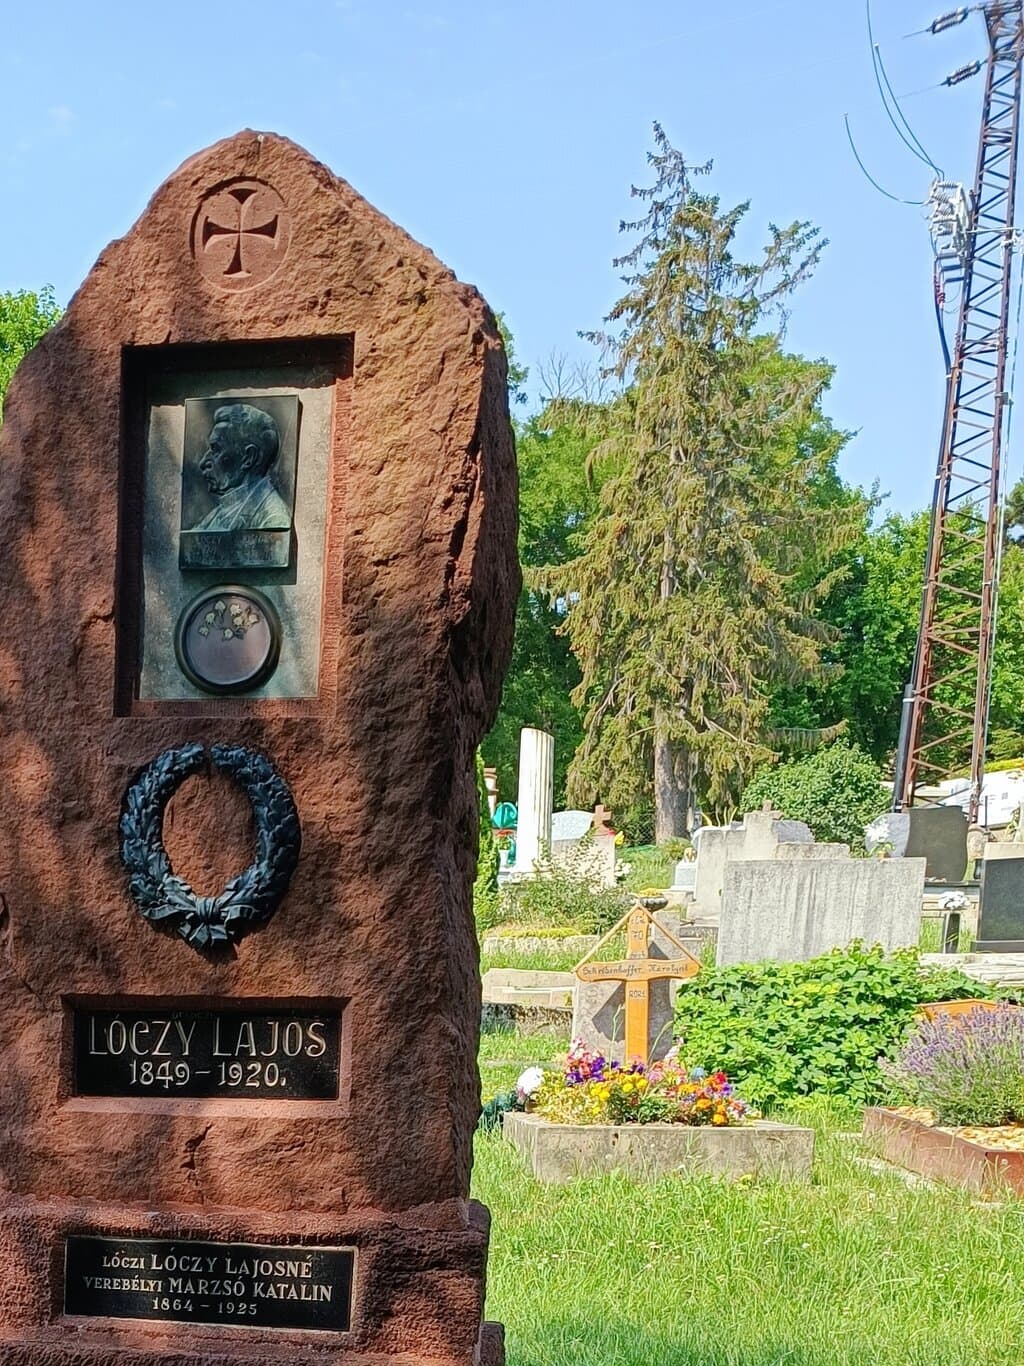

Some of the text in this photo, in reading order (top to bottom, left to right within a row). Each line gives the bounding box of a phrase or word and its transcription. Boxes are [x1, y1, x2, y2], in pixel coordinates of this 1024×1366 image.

[89, 1013, 327, 1058] LÓCZY LAJOS
[150, 1246, 217, 1273] LÓCZY
[225, 1254, 314, 1279] LAJOSNÉ
[83, 1274, 333, 1302] VEREBÉLYI MARZSÓ KATALIN
